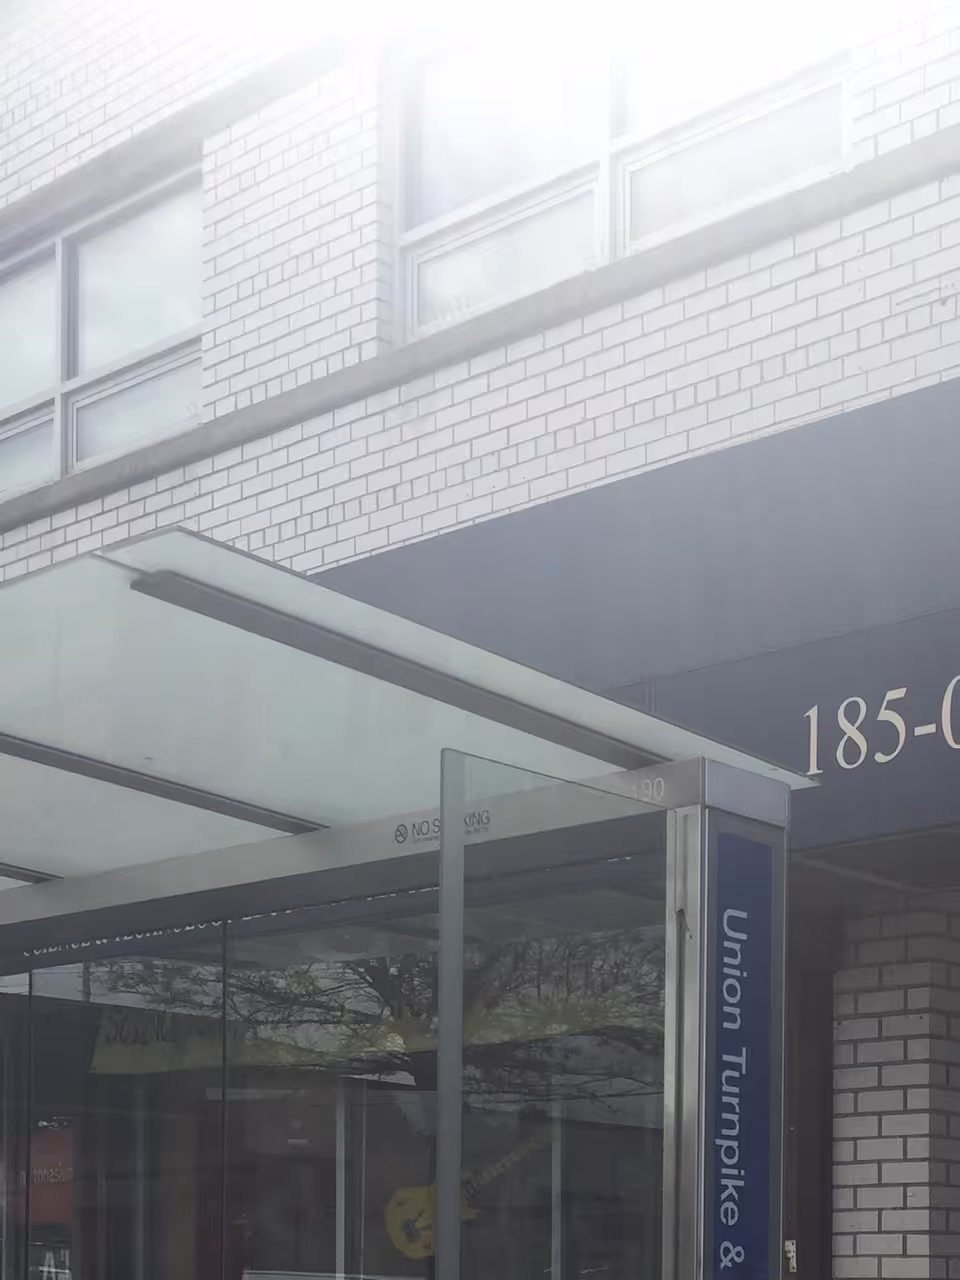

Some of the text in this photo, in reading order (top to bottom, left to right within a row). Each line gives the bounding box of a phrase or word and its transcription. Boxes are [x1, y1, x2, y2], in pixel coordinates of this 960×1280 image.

[411, 820, 430, 838] NO
[432, 808, 491, 834] SKING
[722, 908, 748, 1030] Union
[714, 1047, 747, 1226] Turnpike
[720, 1240, 745, 1269] &
